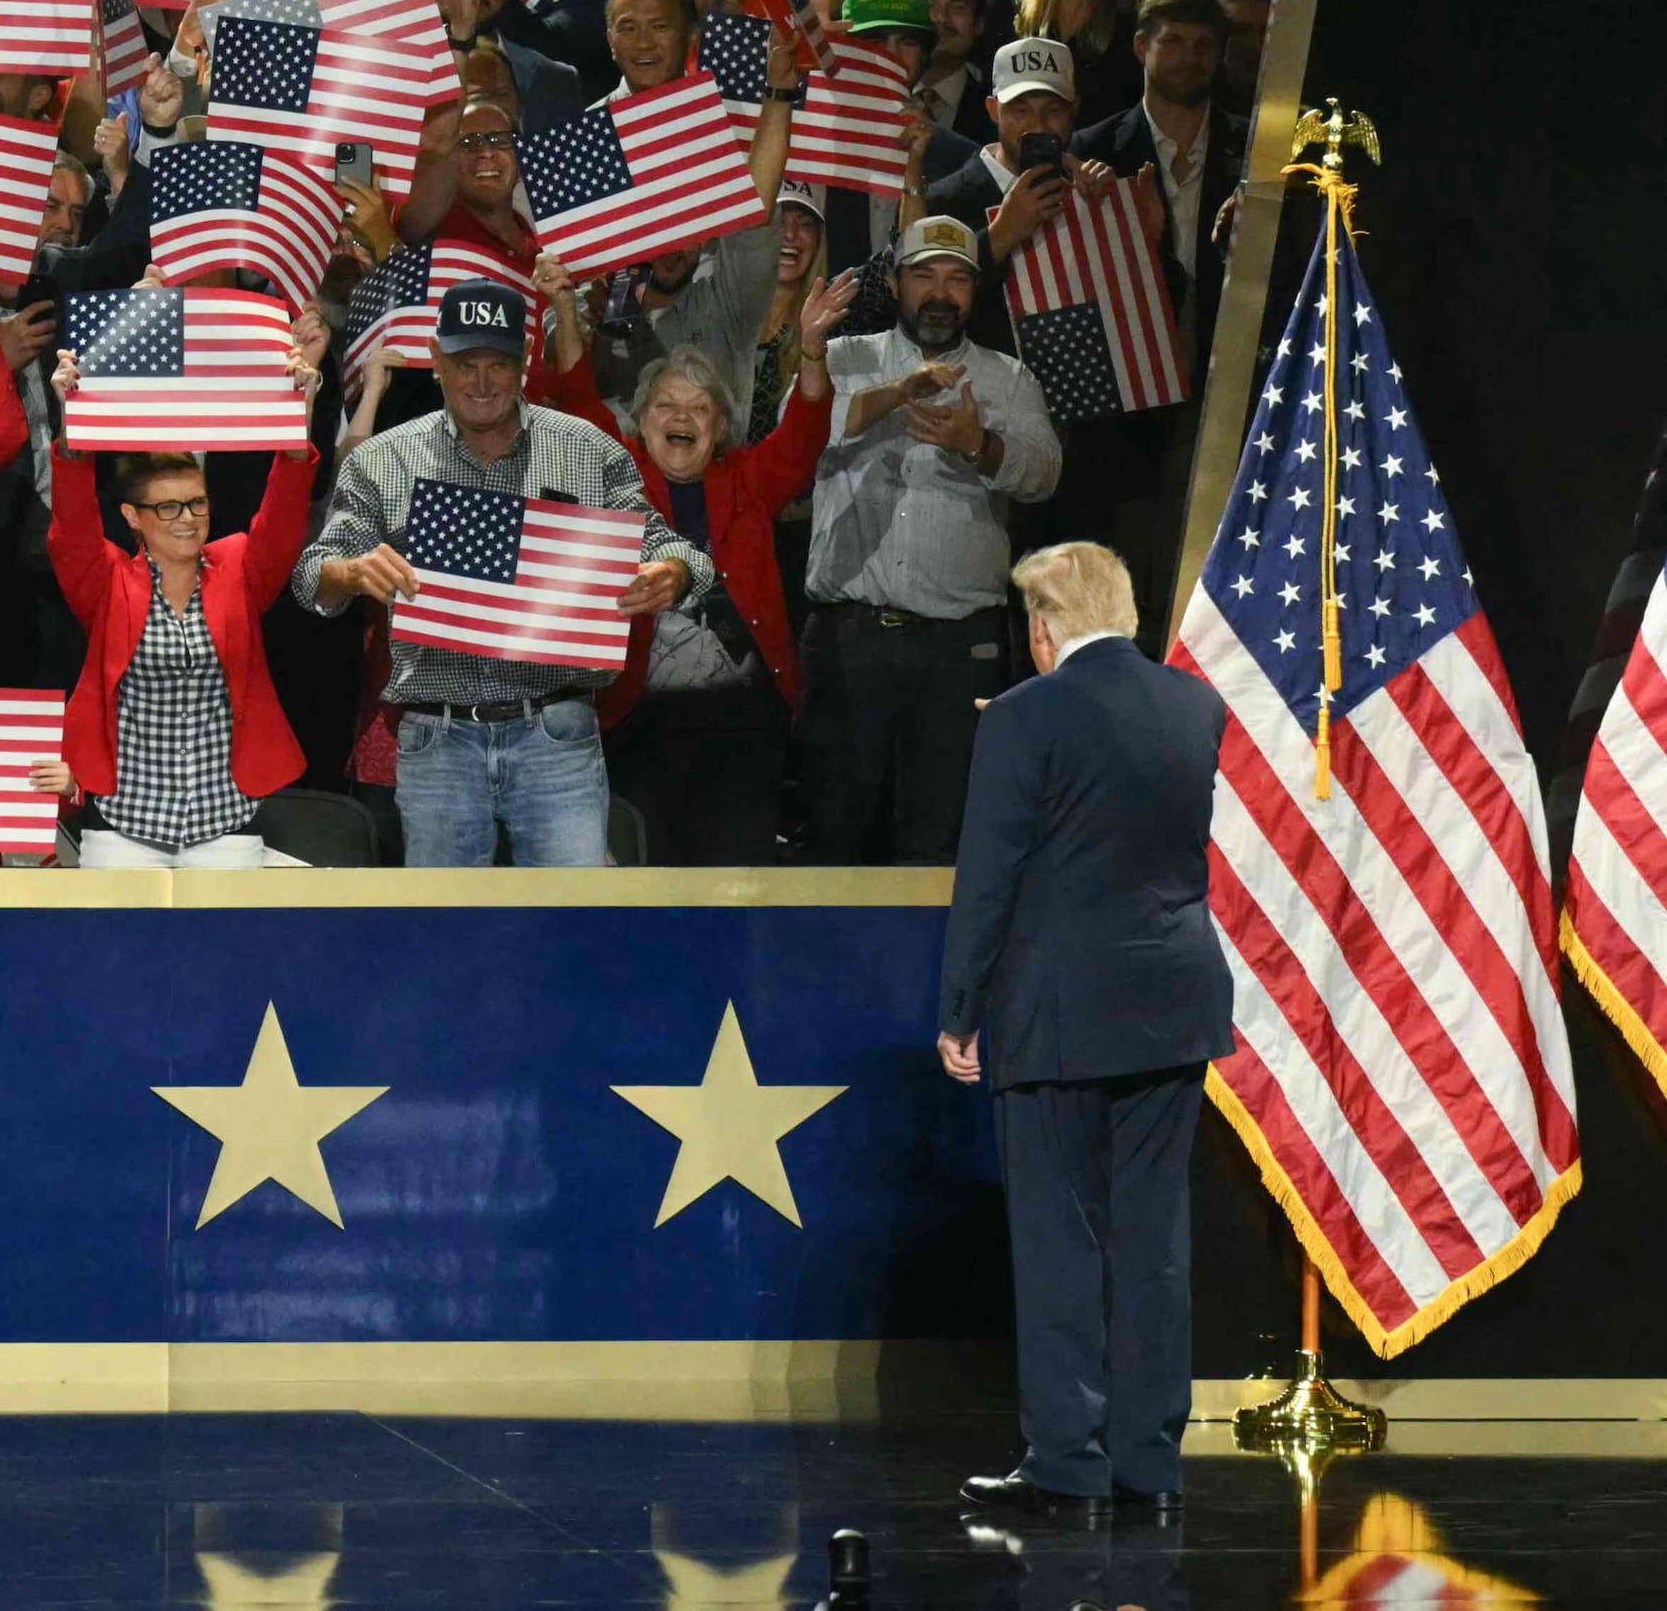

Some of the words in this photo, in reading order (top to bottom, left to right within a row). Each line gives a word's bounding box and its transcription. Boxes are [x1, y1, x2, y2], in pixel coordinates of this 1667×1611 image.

[1011, 51, 1060, 74] USA
[783, 179, 813, 199] SA
[459, 301, 509, 328] USA
